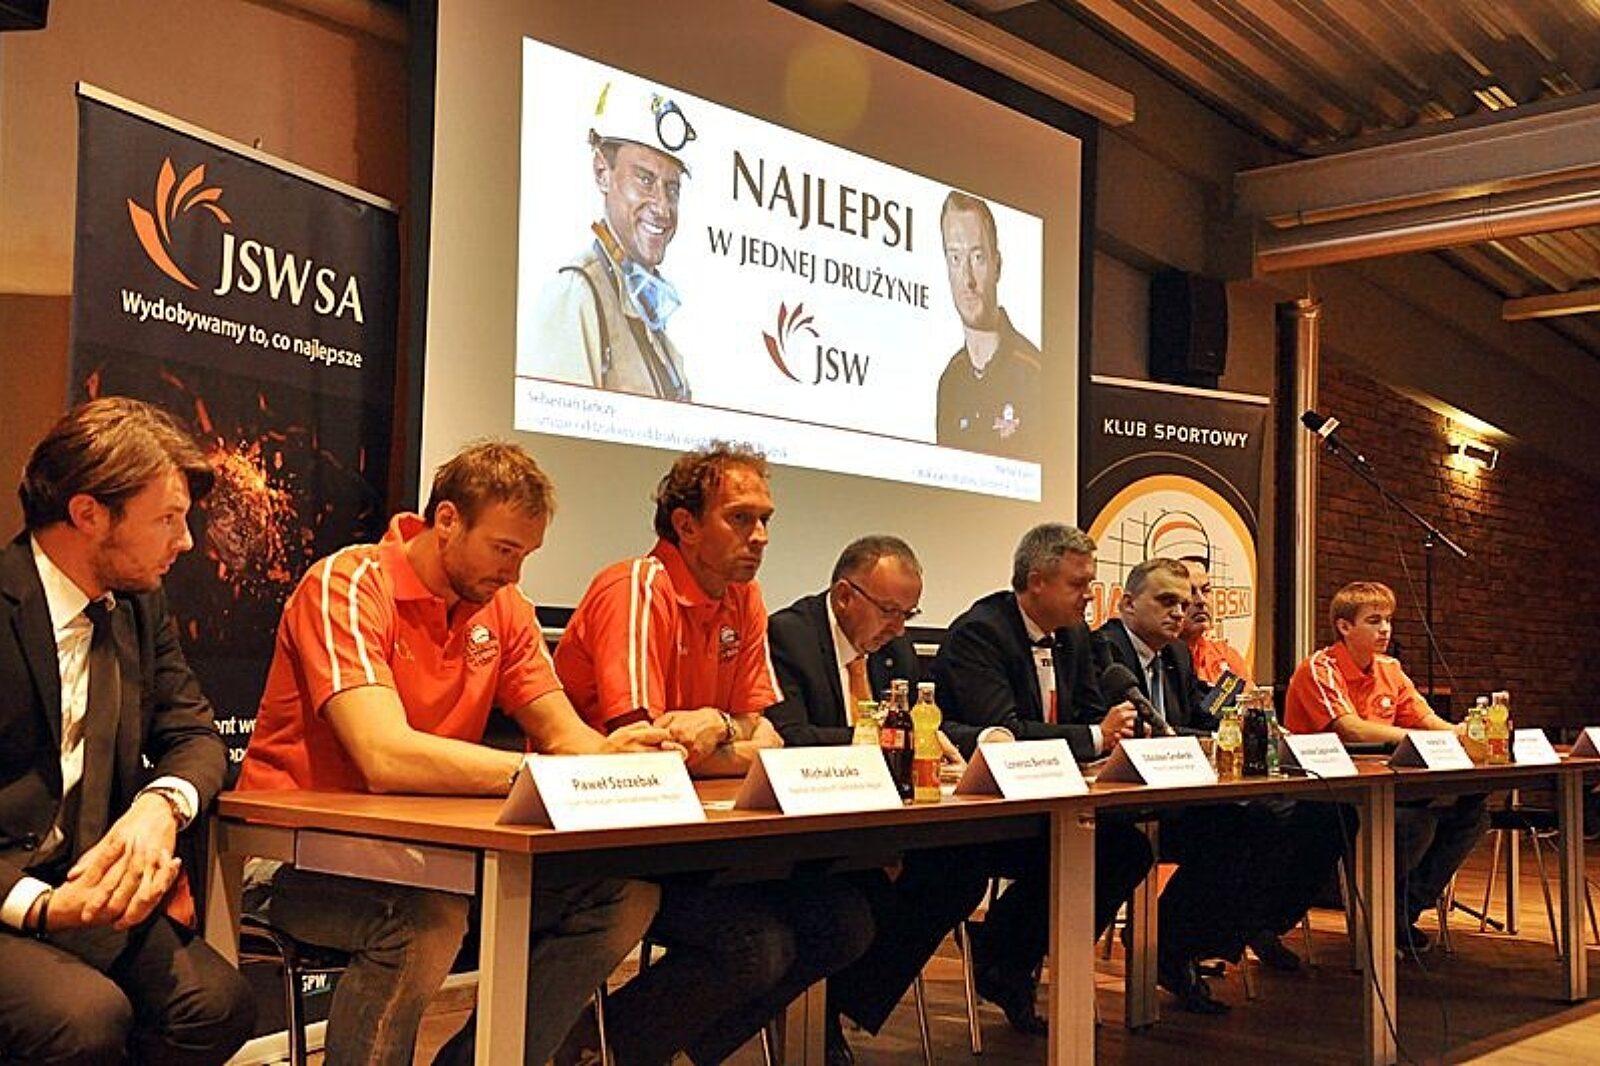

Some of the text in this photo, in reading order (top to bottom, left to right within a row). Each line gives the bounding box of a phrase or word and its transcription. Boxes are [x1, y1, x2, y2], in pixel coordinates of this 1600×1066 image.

[733, 150, 913, 252] NAJLEPSI
[214, 232, 364, 324] JSW SA
[707, 225, 930, 310] W JEDNEJ DRUŻYNIE
[120, 288, 363, 369] Wydobywamy to, co najlepsze
[812, 344, 870, 387] JSW
[1103, 418, 1249, 449] KLUB SPORTOWY
